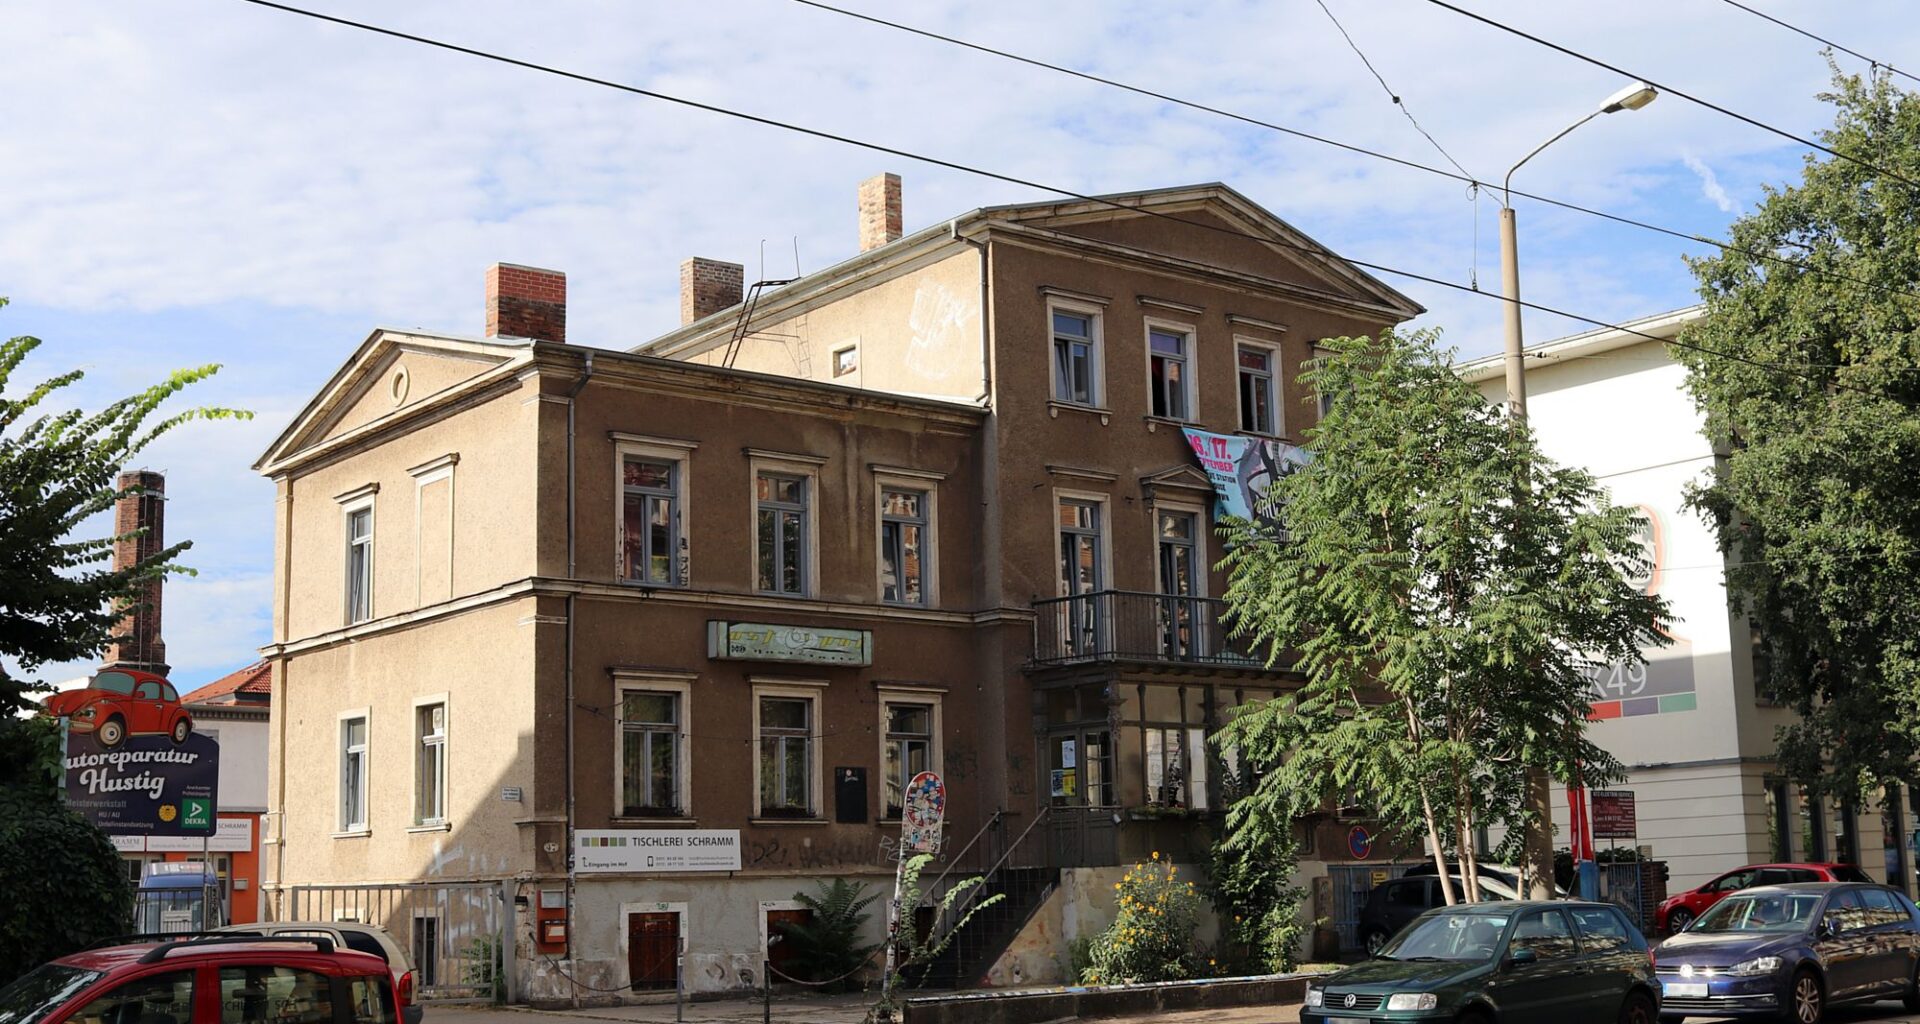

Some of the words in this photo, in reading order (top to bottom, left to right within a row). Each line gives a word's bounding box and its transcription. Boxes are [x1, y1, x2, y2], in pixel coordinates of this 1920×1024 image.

[66, 749, 198, 772] utoreparatur
[79, 768, 165, 800] Hustig
[632, 837, 684, 847] TISCHLEREI
[687, 836, 734, 847] SCHRAMM
